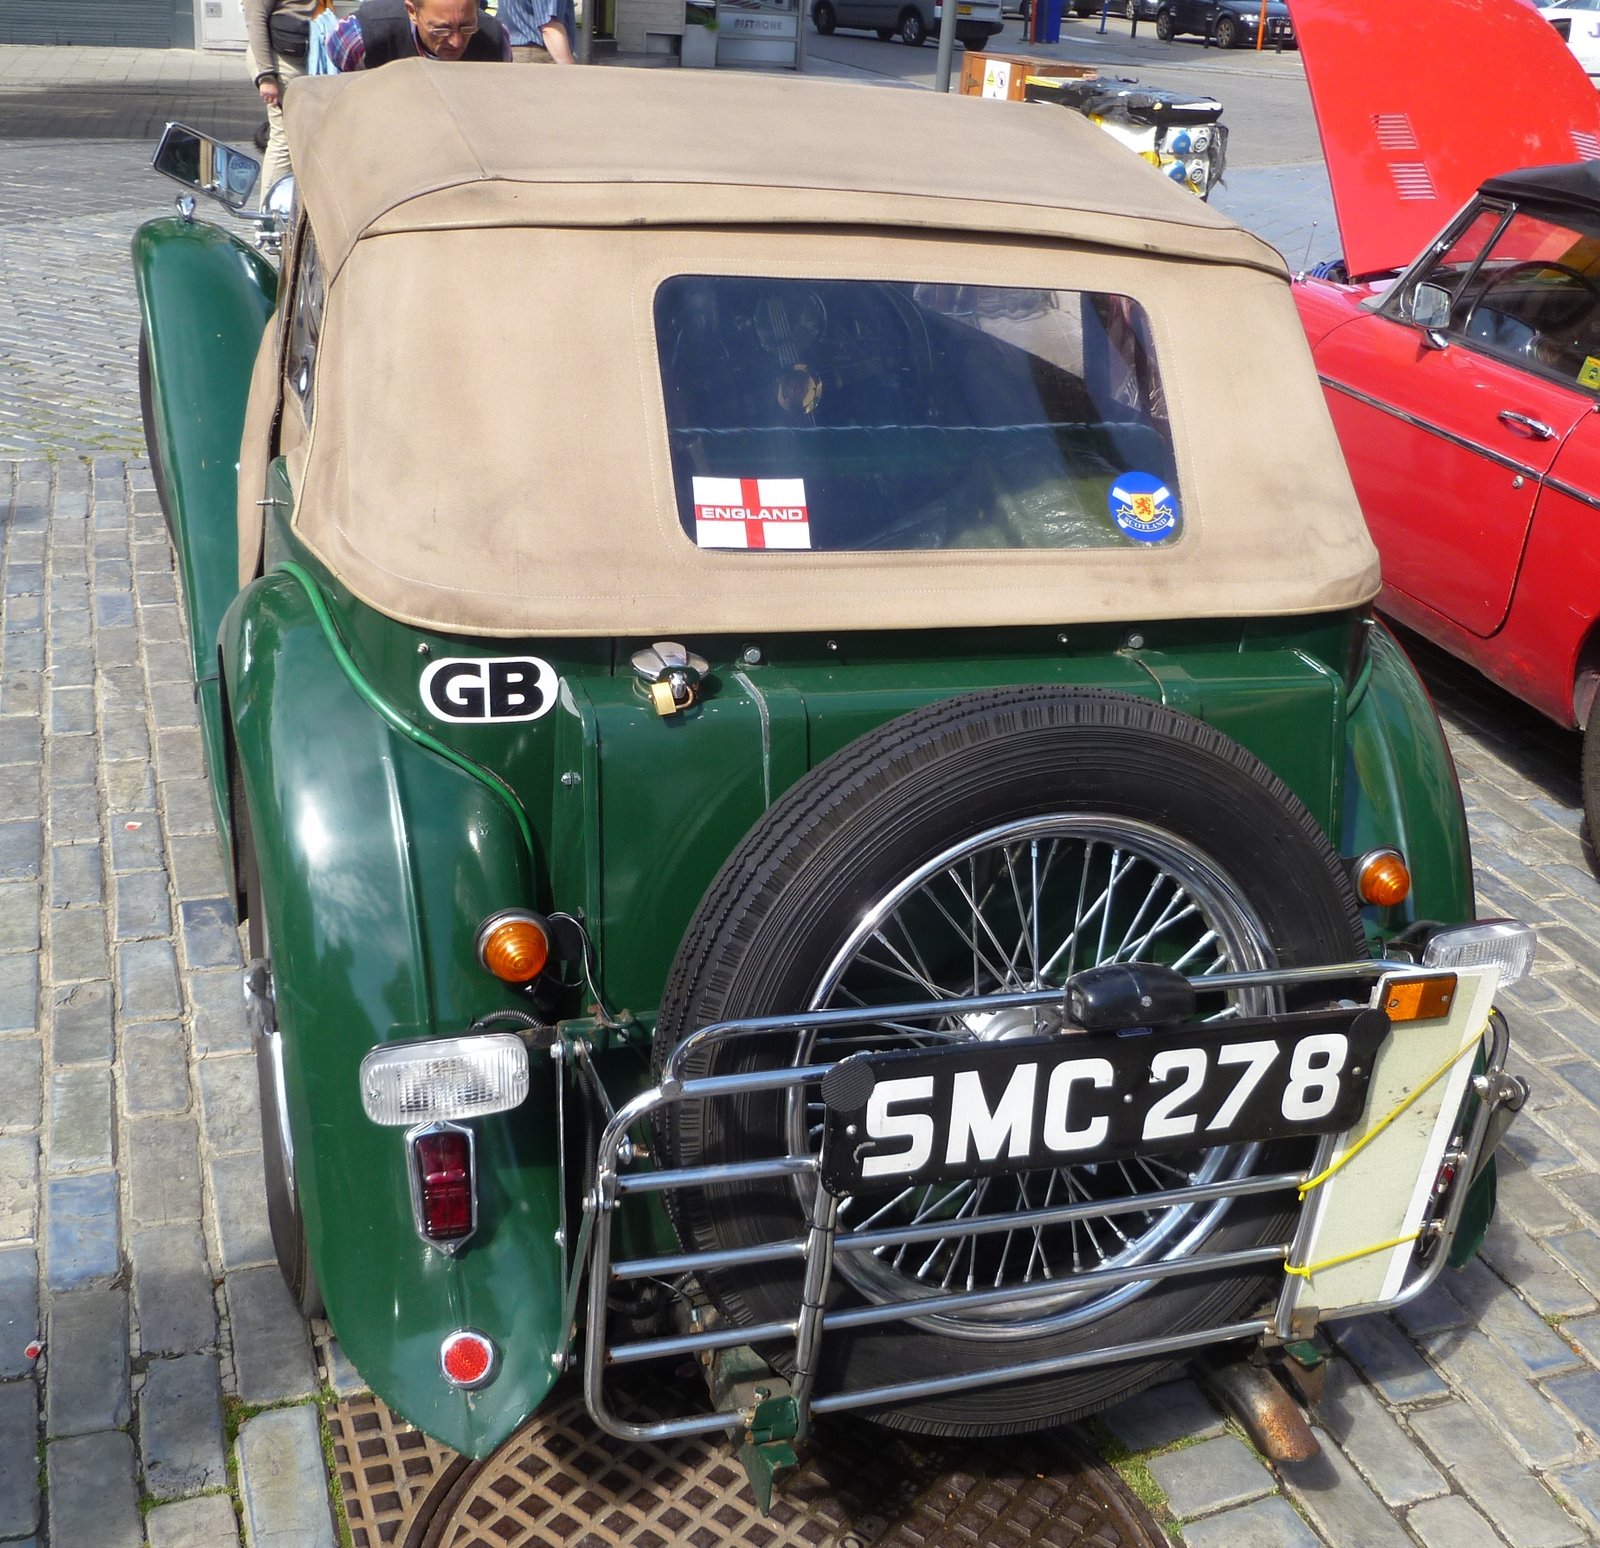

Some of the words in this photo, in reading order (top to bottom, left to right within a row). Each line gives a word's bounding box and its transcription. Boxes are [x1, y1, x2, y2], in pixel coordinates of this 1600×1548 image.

[701, 507, 803, 520] ENGLAND
[1124, 516, 1168, 531] SCOTLAND
[430, 661, 544, 718] GB
[862, 1057, 1114, 1177] SMC
[1141, 1033, 1349, 1140] 278
